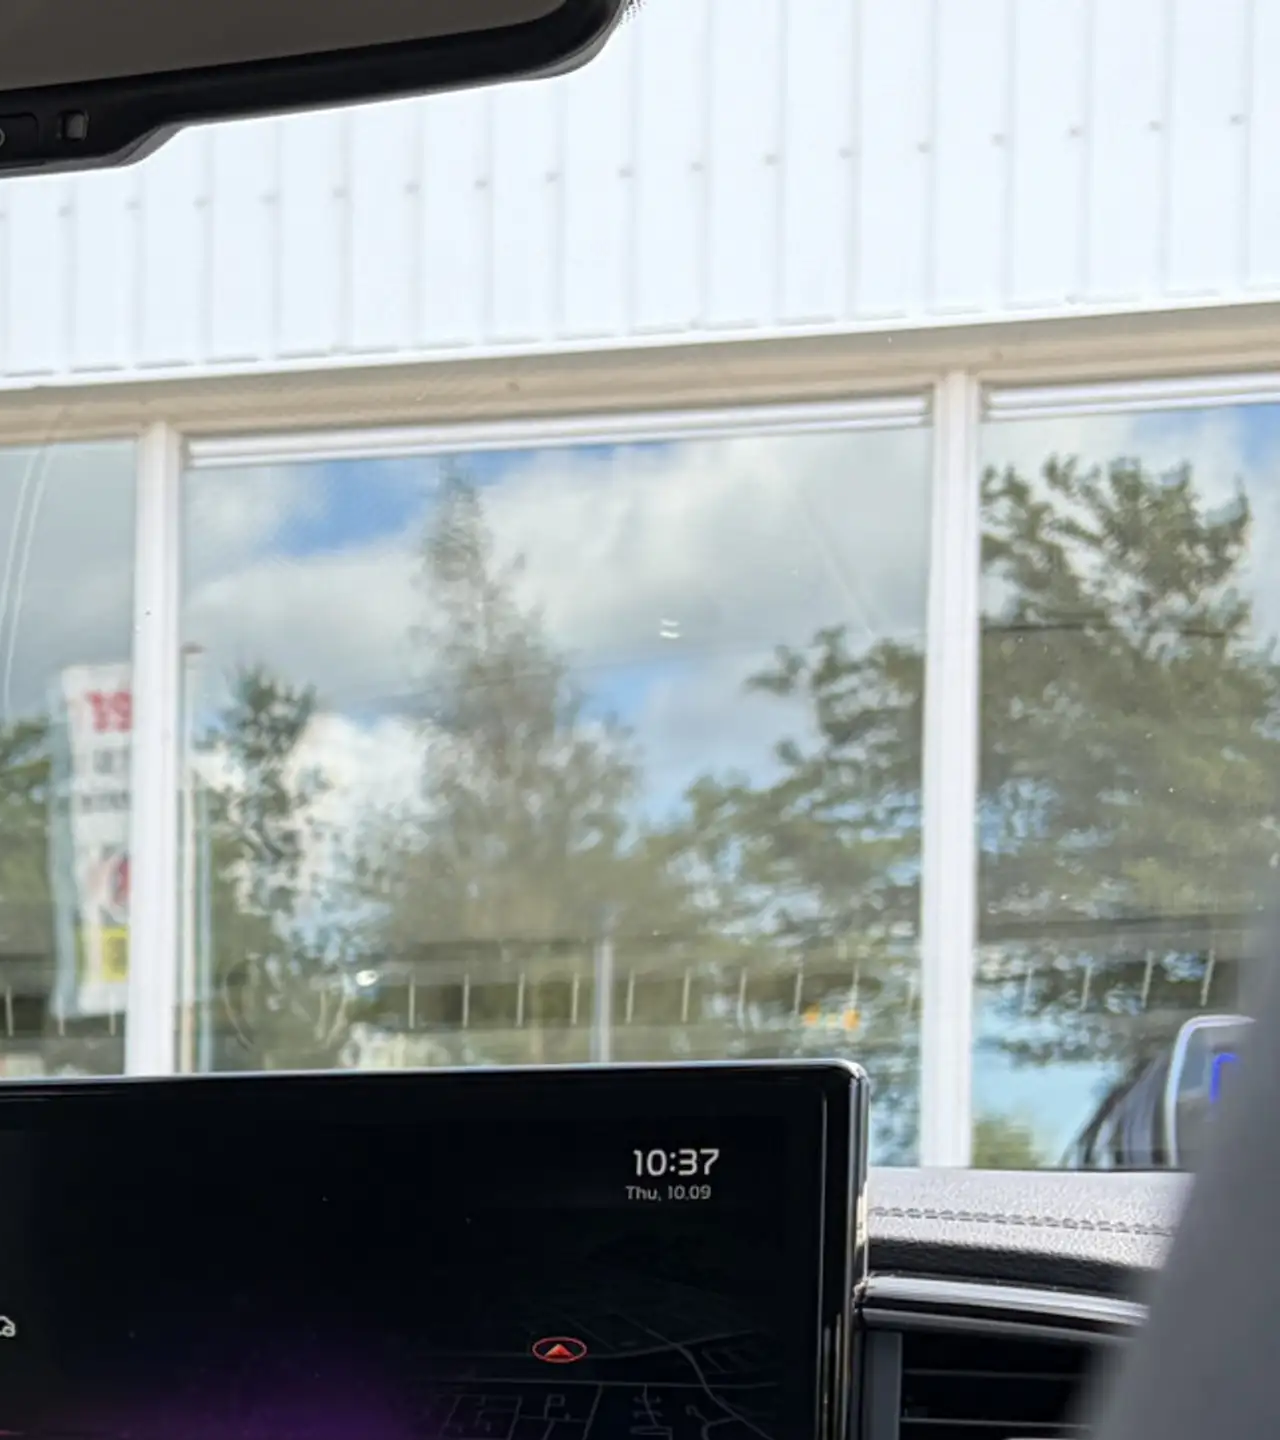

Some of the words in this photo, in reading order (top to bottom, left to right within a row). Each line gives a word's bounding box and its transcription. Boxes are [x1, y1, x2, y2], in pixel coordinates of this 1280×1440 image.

[633, 1148, 720, 1176] 10:37
[625, 1185, 662, 1202] Thu,
[667, 1184, 712, 1200] 10.09
